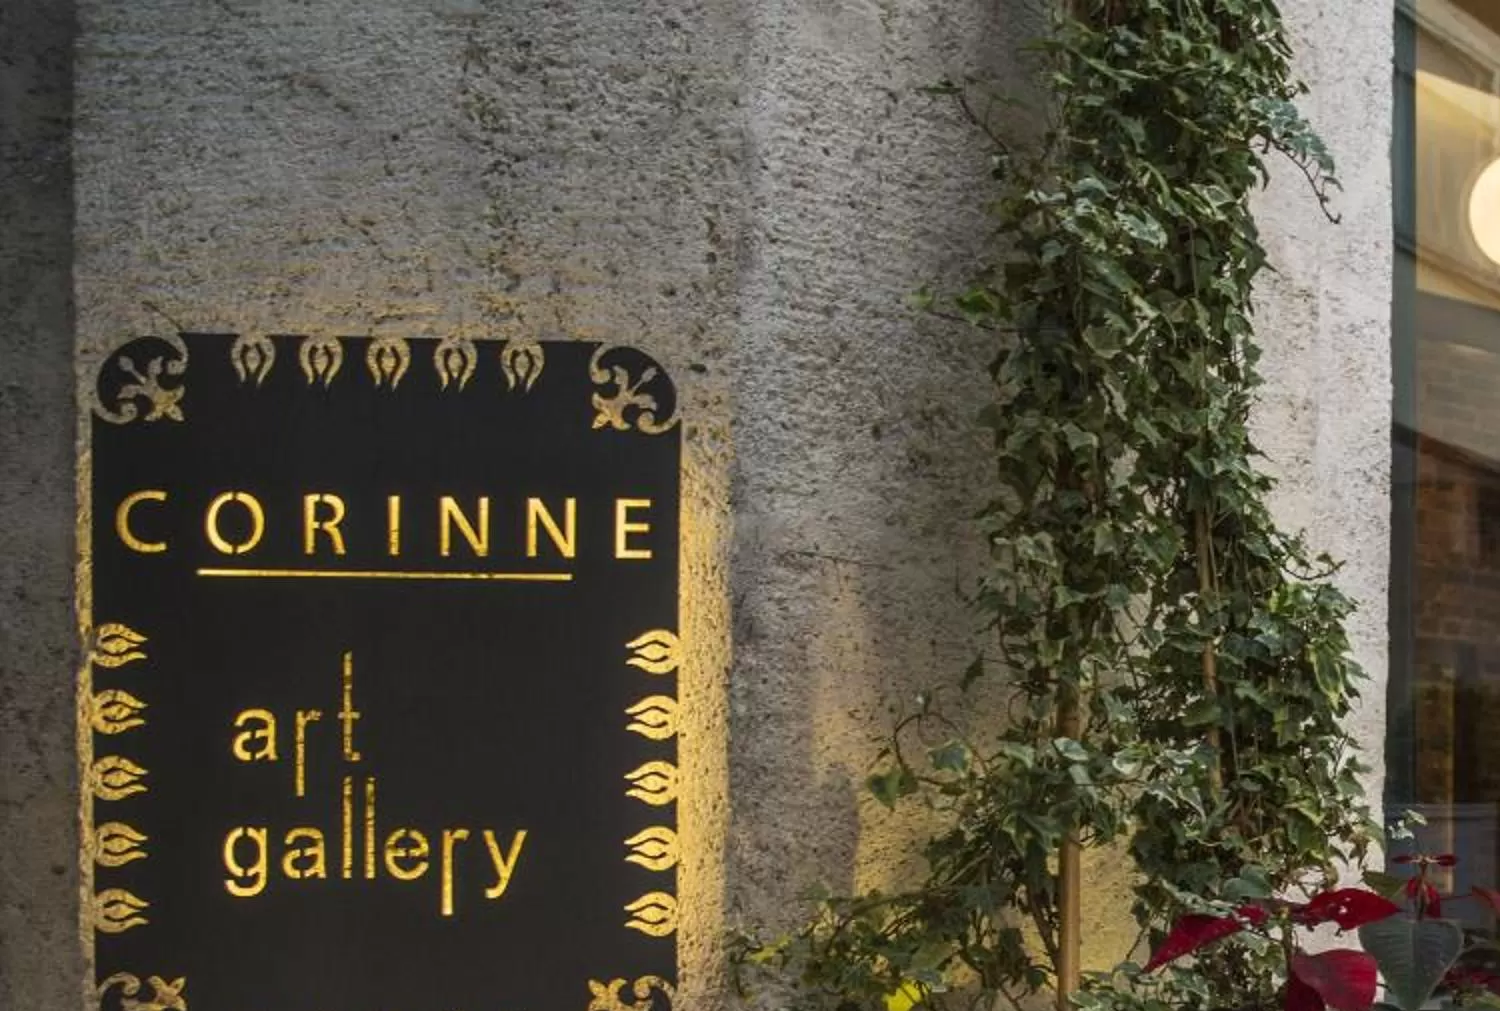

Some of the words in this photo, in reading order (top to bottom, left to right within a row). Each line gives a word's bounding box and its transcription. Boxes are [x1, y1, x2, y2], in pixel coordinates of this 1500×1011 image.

[115, 490, 653, 560] CORINNE
[232, 651, 361, 797] art
[222, 775, 528, 916] gallery
